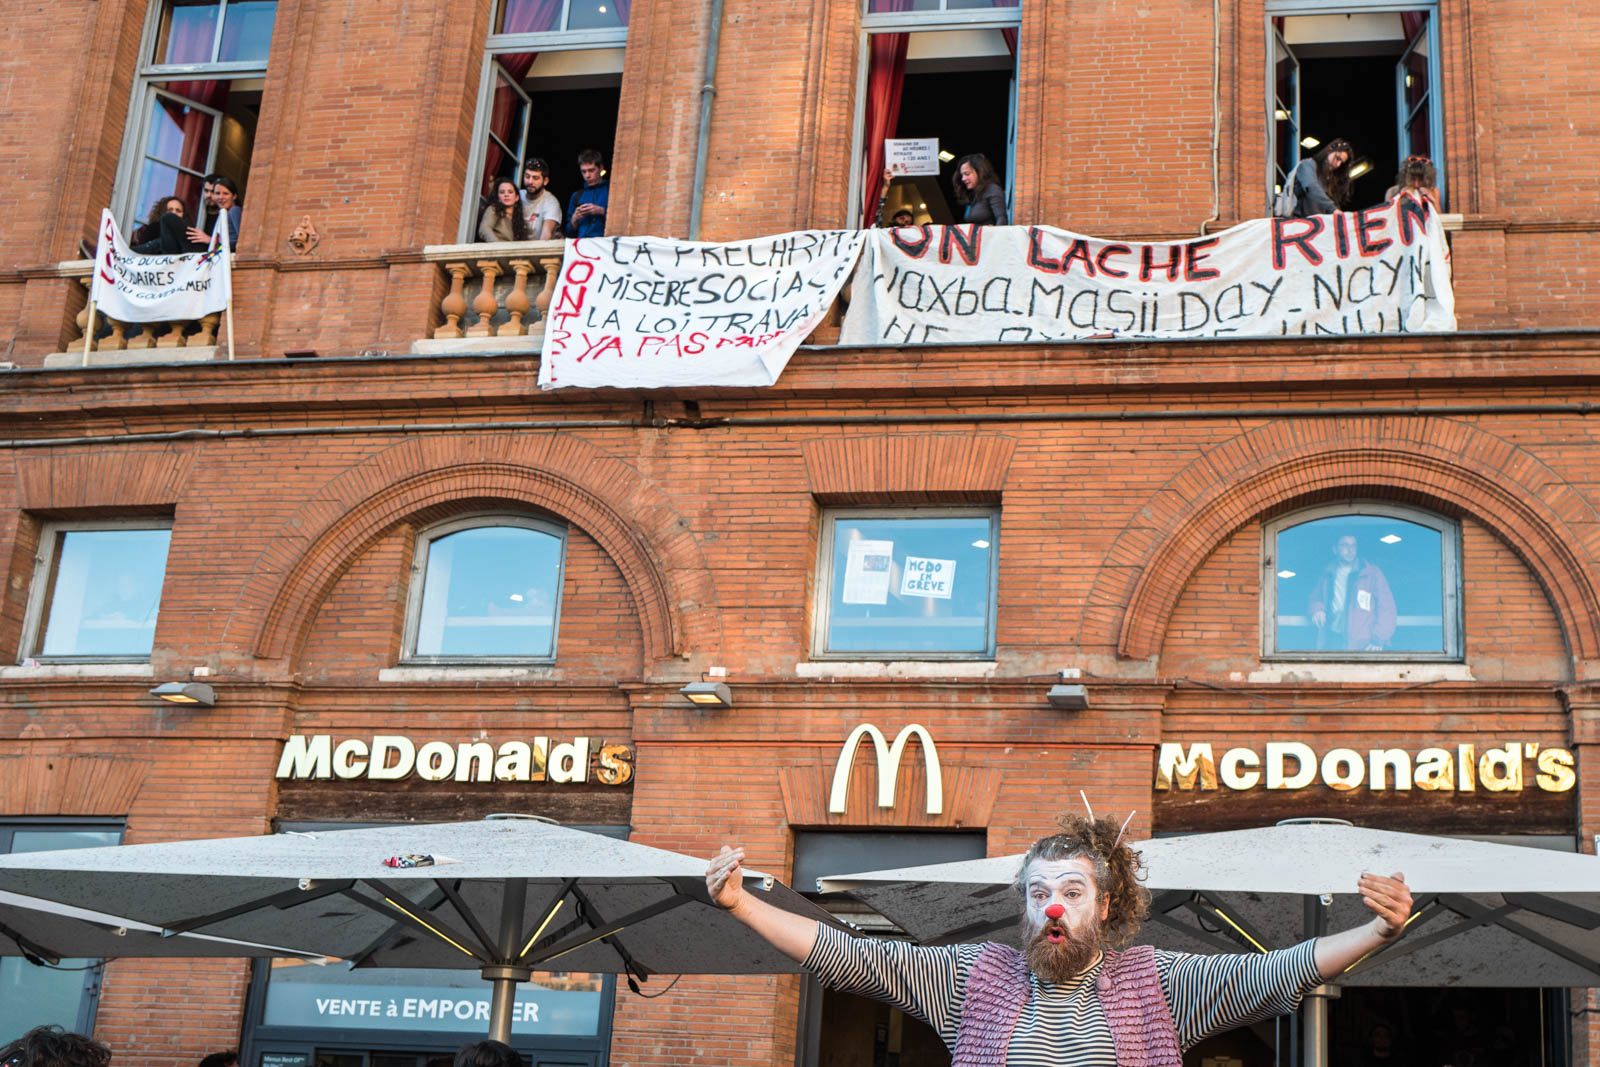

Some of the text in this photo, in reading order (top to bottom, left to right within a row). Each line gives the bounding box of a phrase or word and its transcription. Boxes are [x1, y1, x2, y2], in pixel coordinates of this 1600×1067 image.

[612, 237, 653, 266] LA
[890, 191, 1430, 283] ON LACHE RIEN
[586, 306, 621, 331] LA
[636, 331, 710, 357] PAS
[275, 735, 634, 785] McDonald's
[1155, 742, 1577, 792] McDonald's
[316, 998, 539, 1022] VENTE à EMPORER
